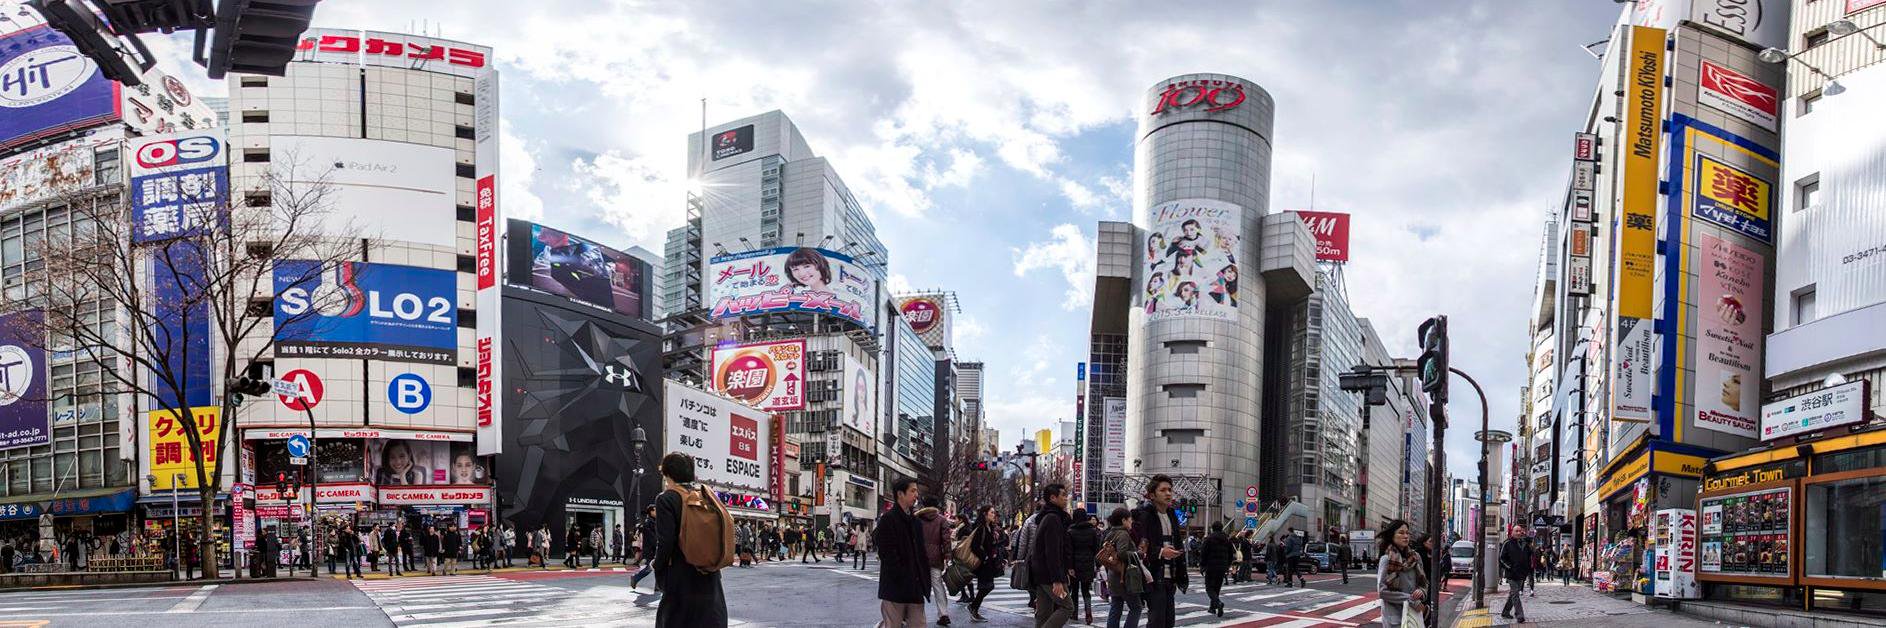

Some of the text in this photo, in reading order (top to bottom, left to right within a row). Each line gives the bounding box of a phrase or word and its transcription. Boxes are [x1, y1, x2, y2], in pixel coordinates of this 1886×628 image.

[1151, 85, 1247, 115] 109
[1633, 89, 1655, 159] Matsumoto
[139, 137, 216, 165] OS
[142, 172, 216, 205] 調剤
[1711, 165, 1760, 213] 薬
[142, 202, 218, 236] 薬局
[716, 261, 770, 284] メール
[711, 284, 862, 320] ハッピーメール
[332, 346, 354, 354] Solo2
[285, 374, 317, 404] A
[727, 367, 769, 390] 楽園
[397, 379, 424, 408] B
[1801, 392, 1833, 412] 渋谷駅
[680, 399, 717, 417] パチンコは
[731, 425, 757, 440] エスパス
[1699, 410, 1731, 426] BEAUTY
[1732, 420, 1757, 432] SALON
[680, 434, 703, 448] 楽しむ
[726, 458, 760, 478] ESPACE
[1705, 467, 1783, 490] Gourmet Town
[325, 490, 361, 498] CAMERA
[441, 492, 484, 500] ビックカメラ
[1681, 515, 1695, 573] KIRIN
